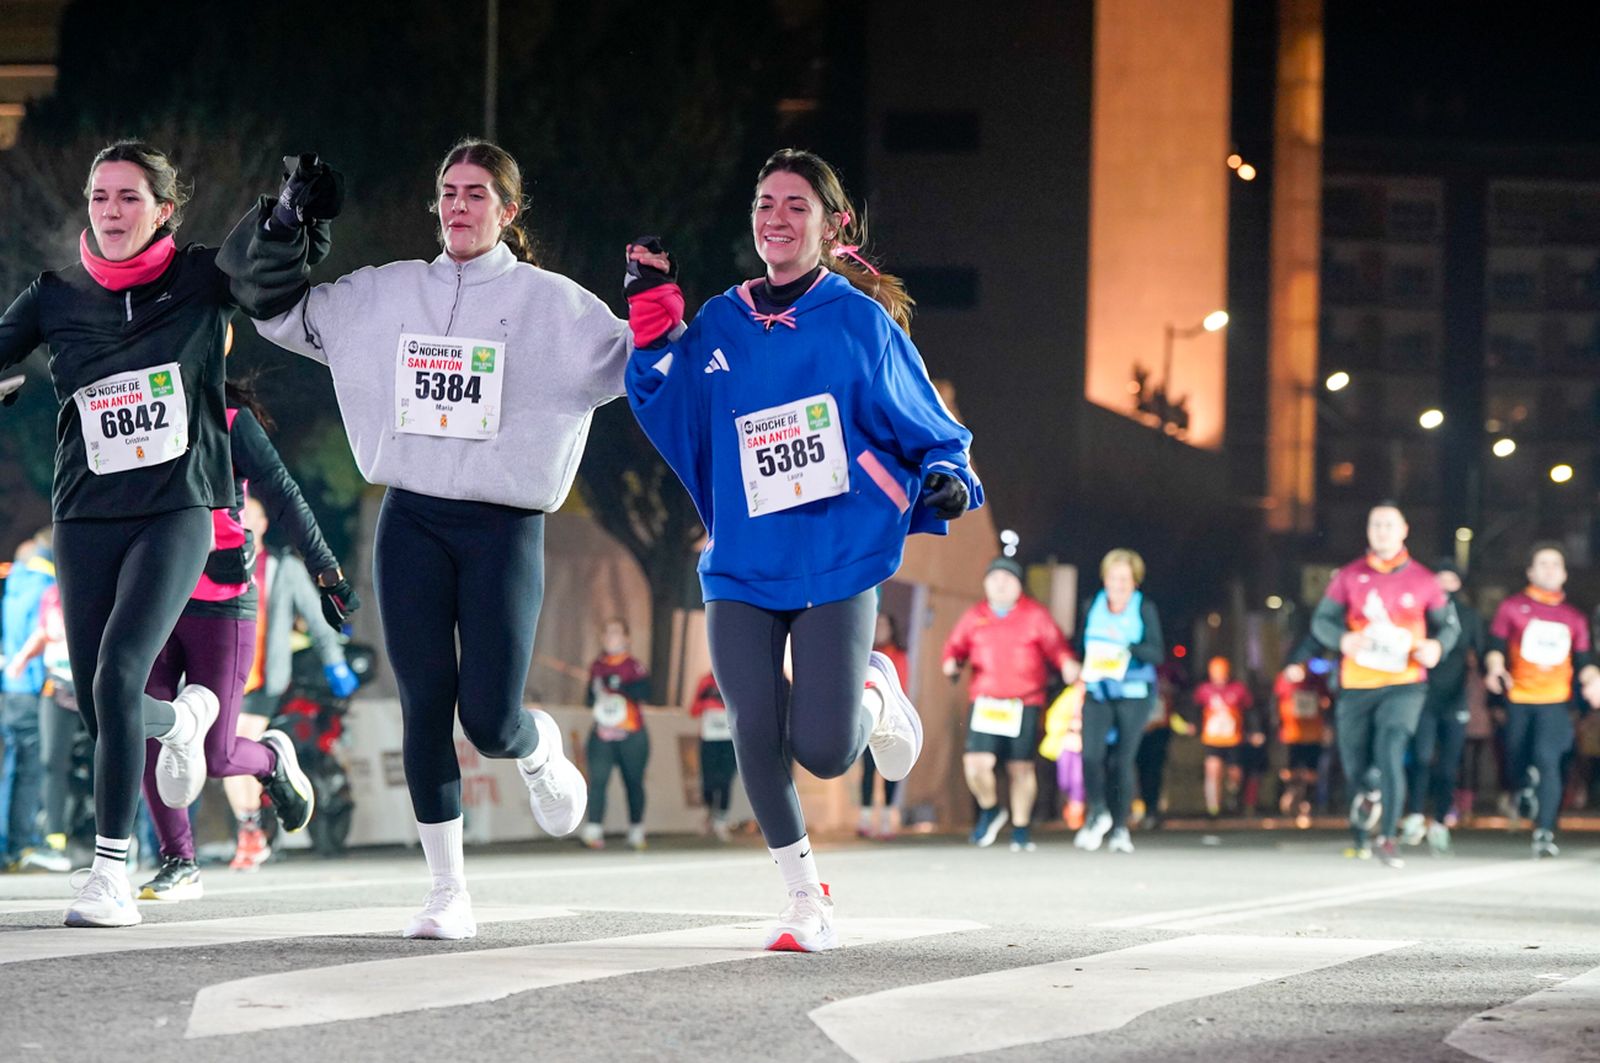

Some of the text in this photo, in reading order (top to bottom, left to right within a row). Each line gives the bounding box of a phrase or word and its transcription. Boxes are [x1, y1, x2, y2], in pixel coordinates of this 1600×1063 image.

[419, 347, 449, 358] NOCHE
[450, 349, 463, 359] DE
[408, 357, 427, 368] SAN
[429, 356, 463, 371] ANTÓN
[98, 383, 127, 397] NOCHE
[128, 381, 140, 391] DE
[415, 371, 481, 404] 5384
[90, 399, 109, 411] SAN
[111, 391, 143, 408] ANTÓN
[101, 401, 169, 439] 6842
[755, 418, 785, 432] NOCHE
[788, 414, 798, 423] DE
[125, 436, 150, 445] Cristina
[747, 434, 767, 449] SAN
[768, 425, 801, 443] ANTÓN
[756, 434, 825, 477] 5385
[786, 472, 804, 482] Laura
